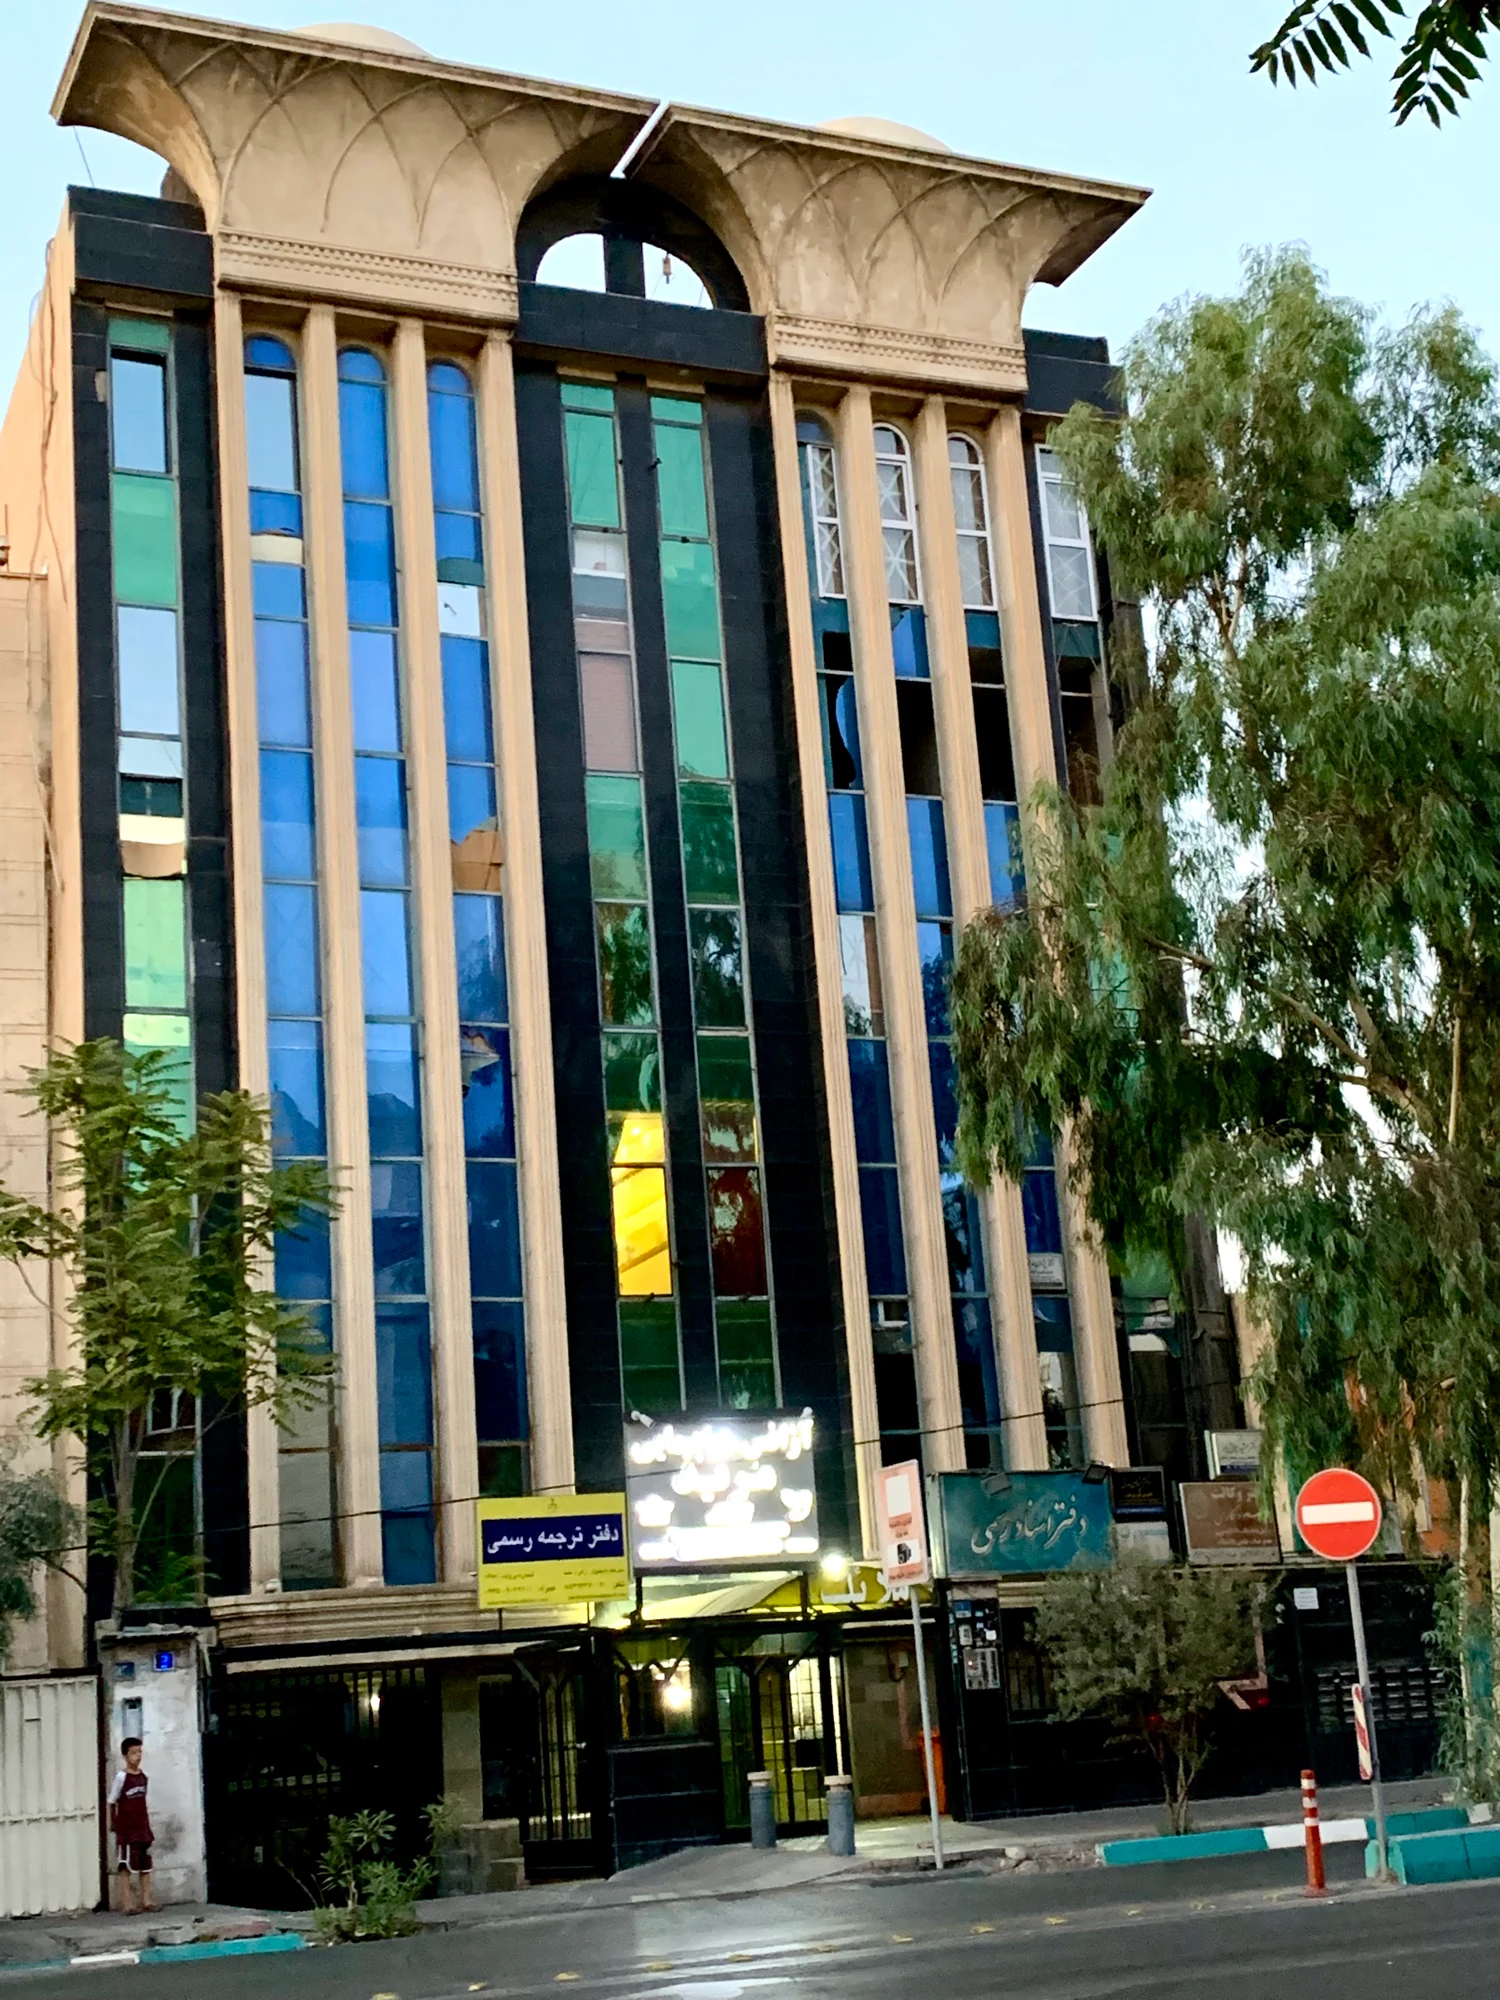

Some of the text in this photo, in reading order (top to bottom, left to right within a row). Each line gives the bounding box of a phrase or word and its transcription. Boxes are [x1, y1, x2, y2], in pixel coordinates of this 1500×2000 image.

[486, 1523, 619, 1554] دفتر ترجمه رسمی
[971, 1494, 1088, 1555] دفتر اسناد رسمی
